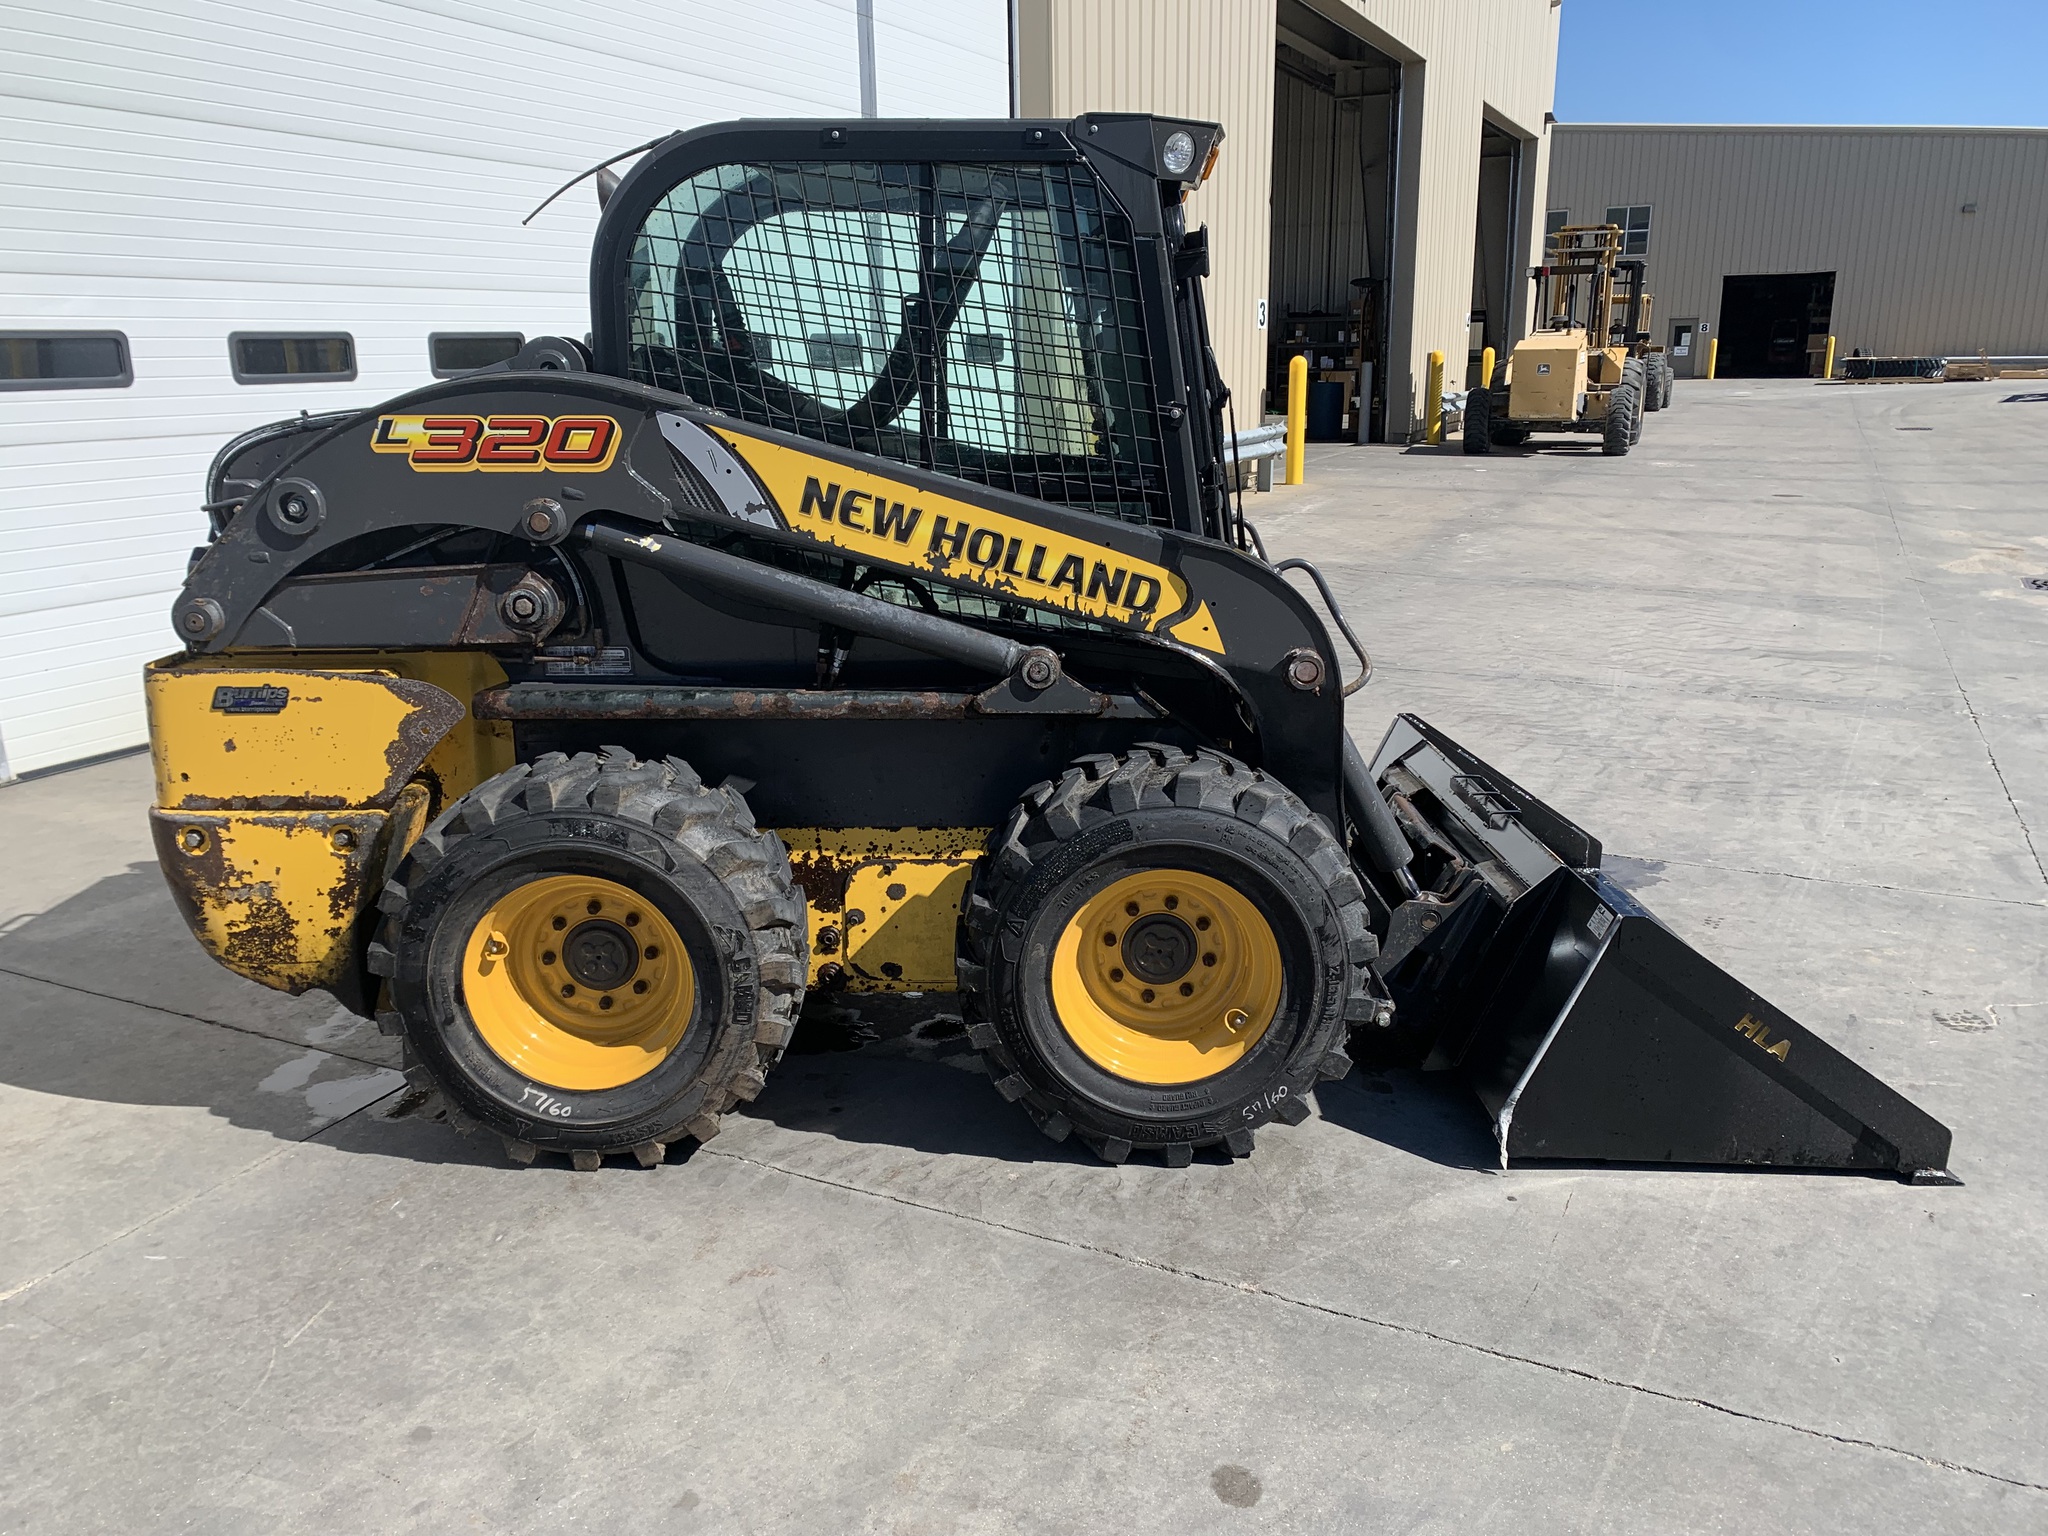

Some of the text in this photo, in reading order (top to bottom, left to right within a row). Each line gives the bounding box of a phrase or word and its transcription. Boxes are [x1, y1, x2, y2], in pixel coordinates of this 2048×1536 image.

[1259, 301, 1266, 327] 3
[1700, 323, 1708, 332] 8
[799, 475, 1162, 613] NEW HOLLAND
[1733, 1012, 1792, 1063] HLA
[1242, 1085, 1288, 1120] 57/60
